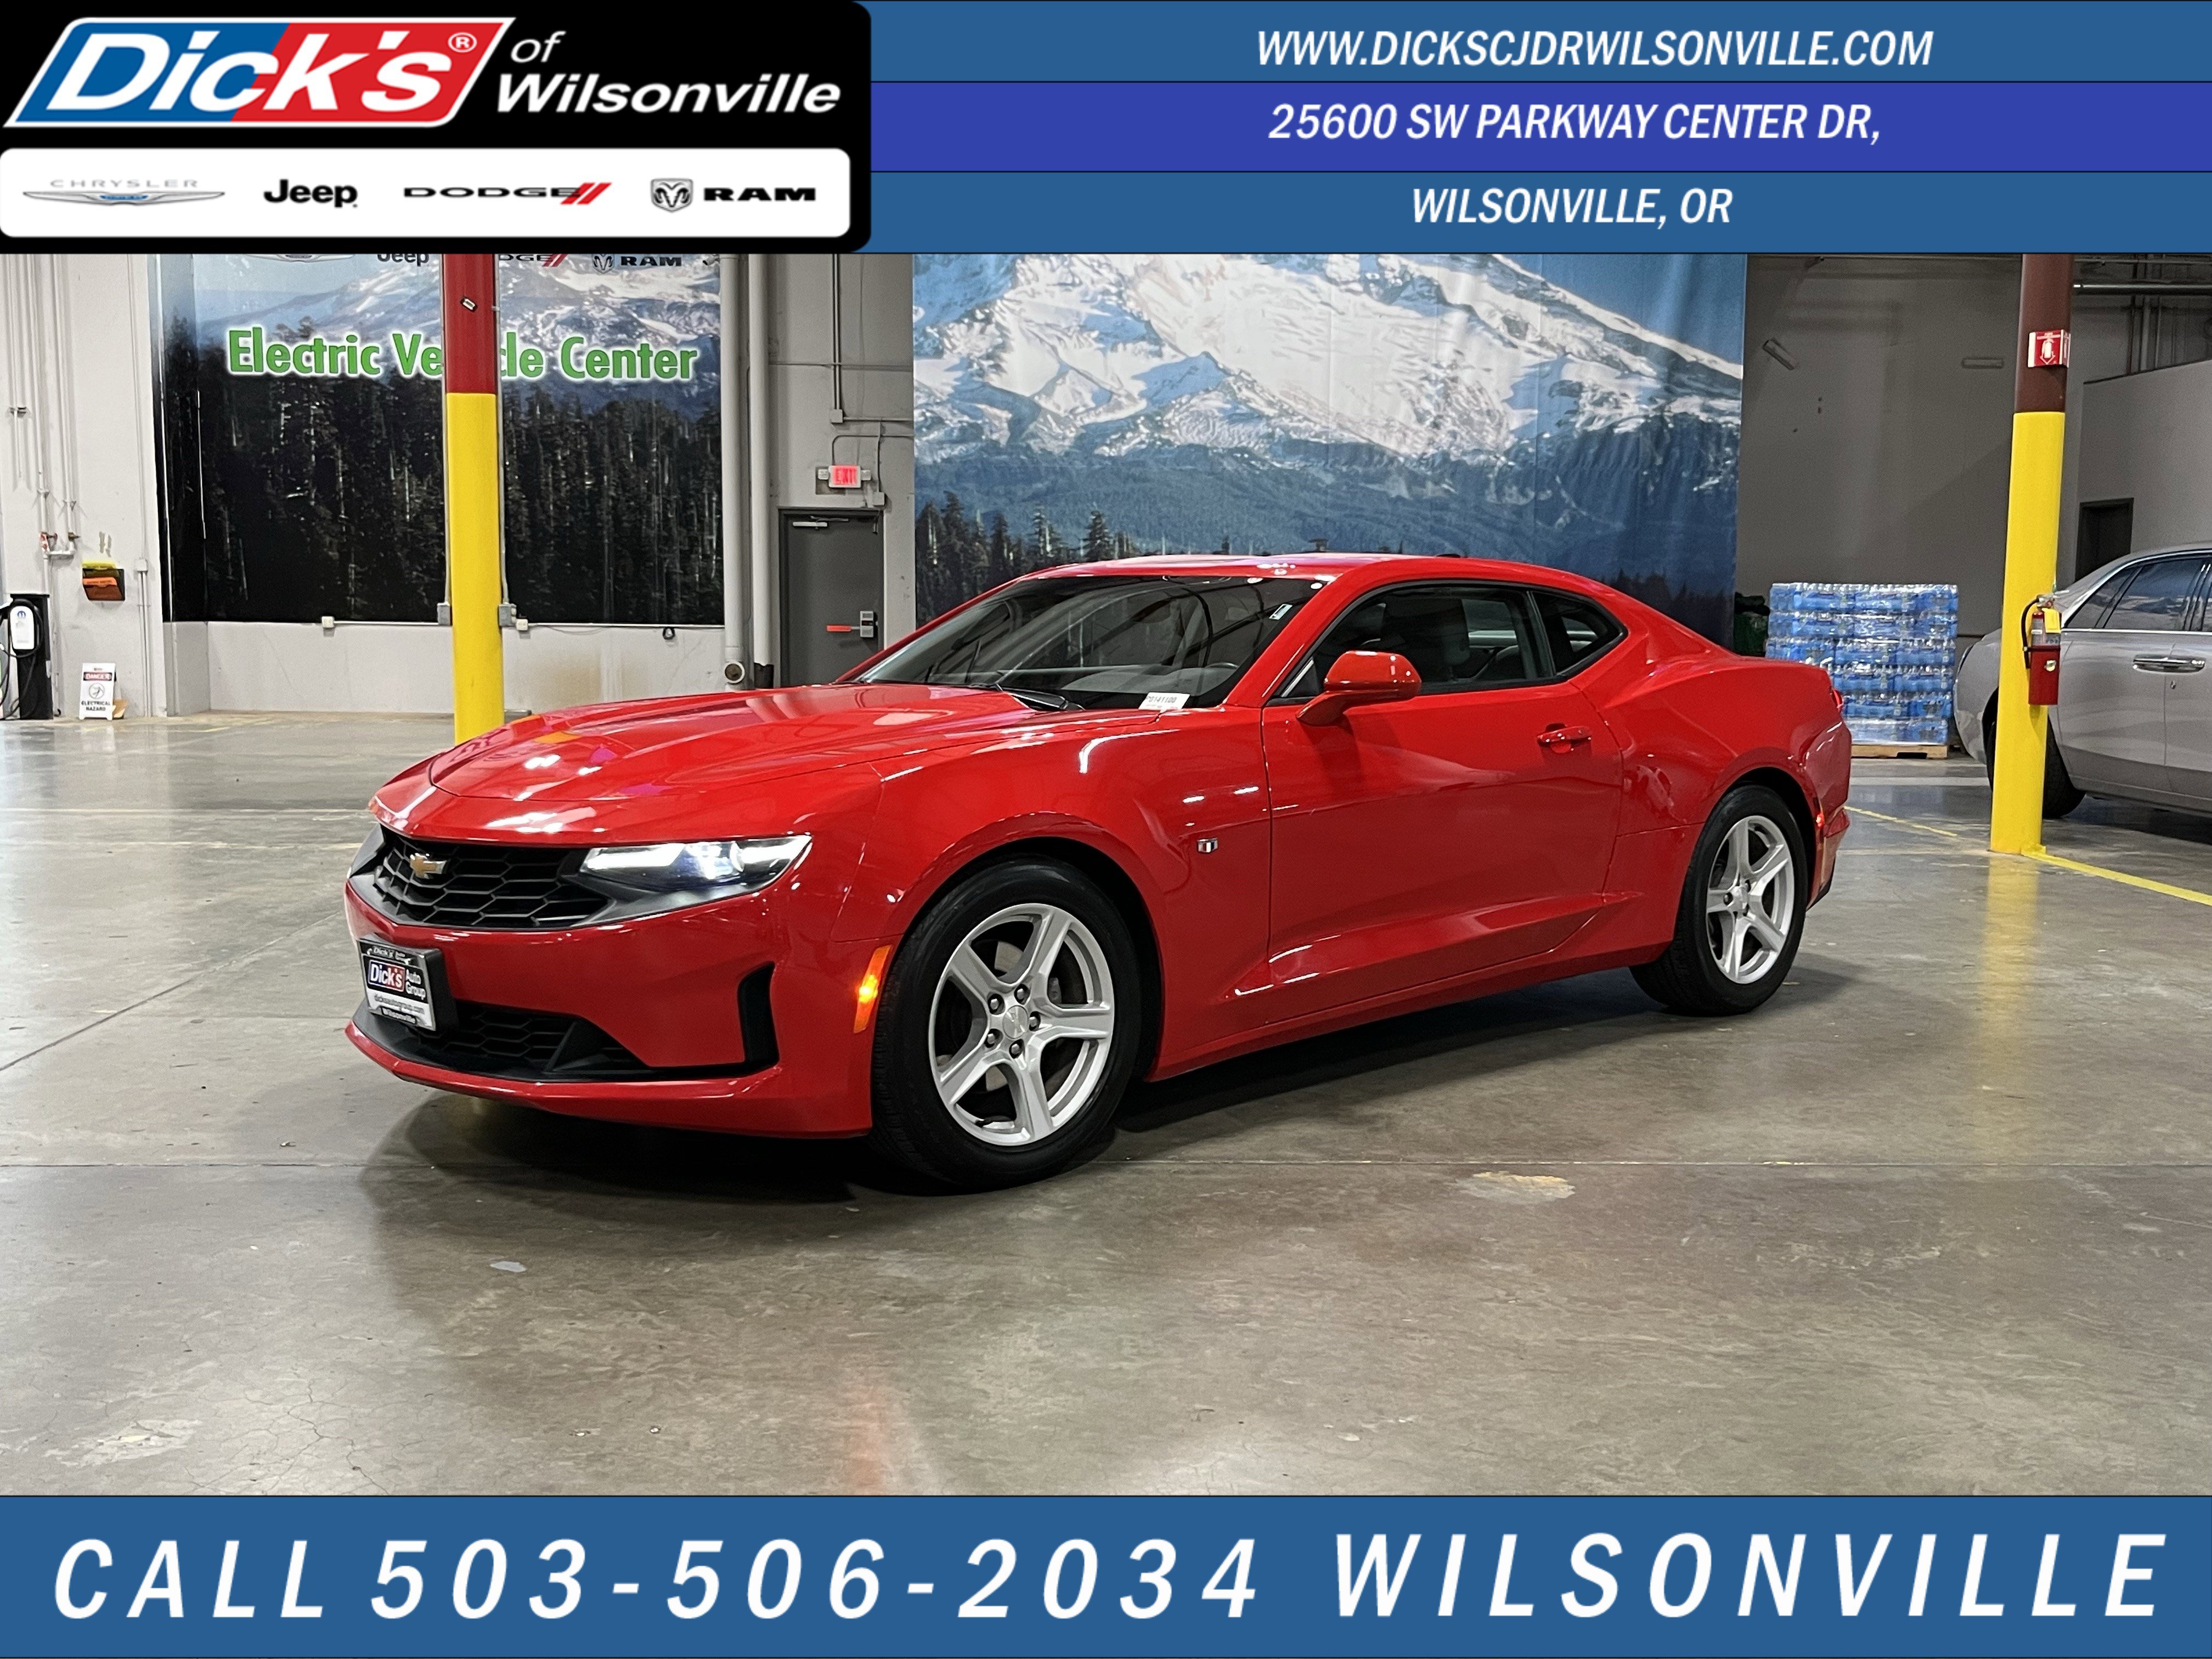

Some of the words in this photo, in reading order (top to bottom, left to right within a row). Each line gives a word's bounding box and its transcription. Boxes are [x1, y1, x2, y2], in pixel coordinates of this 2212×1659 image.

[620, 256, 682, 267] RAM
[228, 327, 381, 374] Electric
[392, 331, 544, 377] Vele
[561, 336, 697, 379] Center
[835, 468, 856, 483] EXIT
[370, 963, 403, 988] Dick's
[406, 969, 421, 985] Auto
[405, 981, 426, 1001] Group
